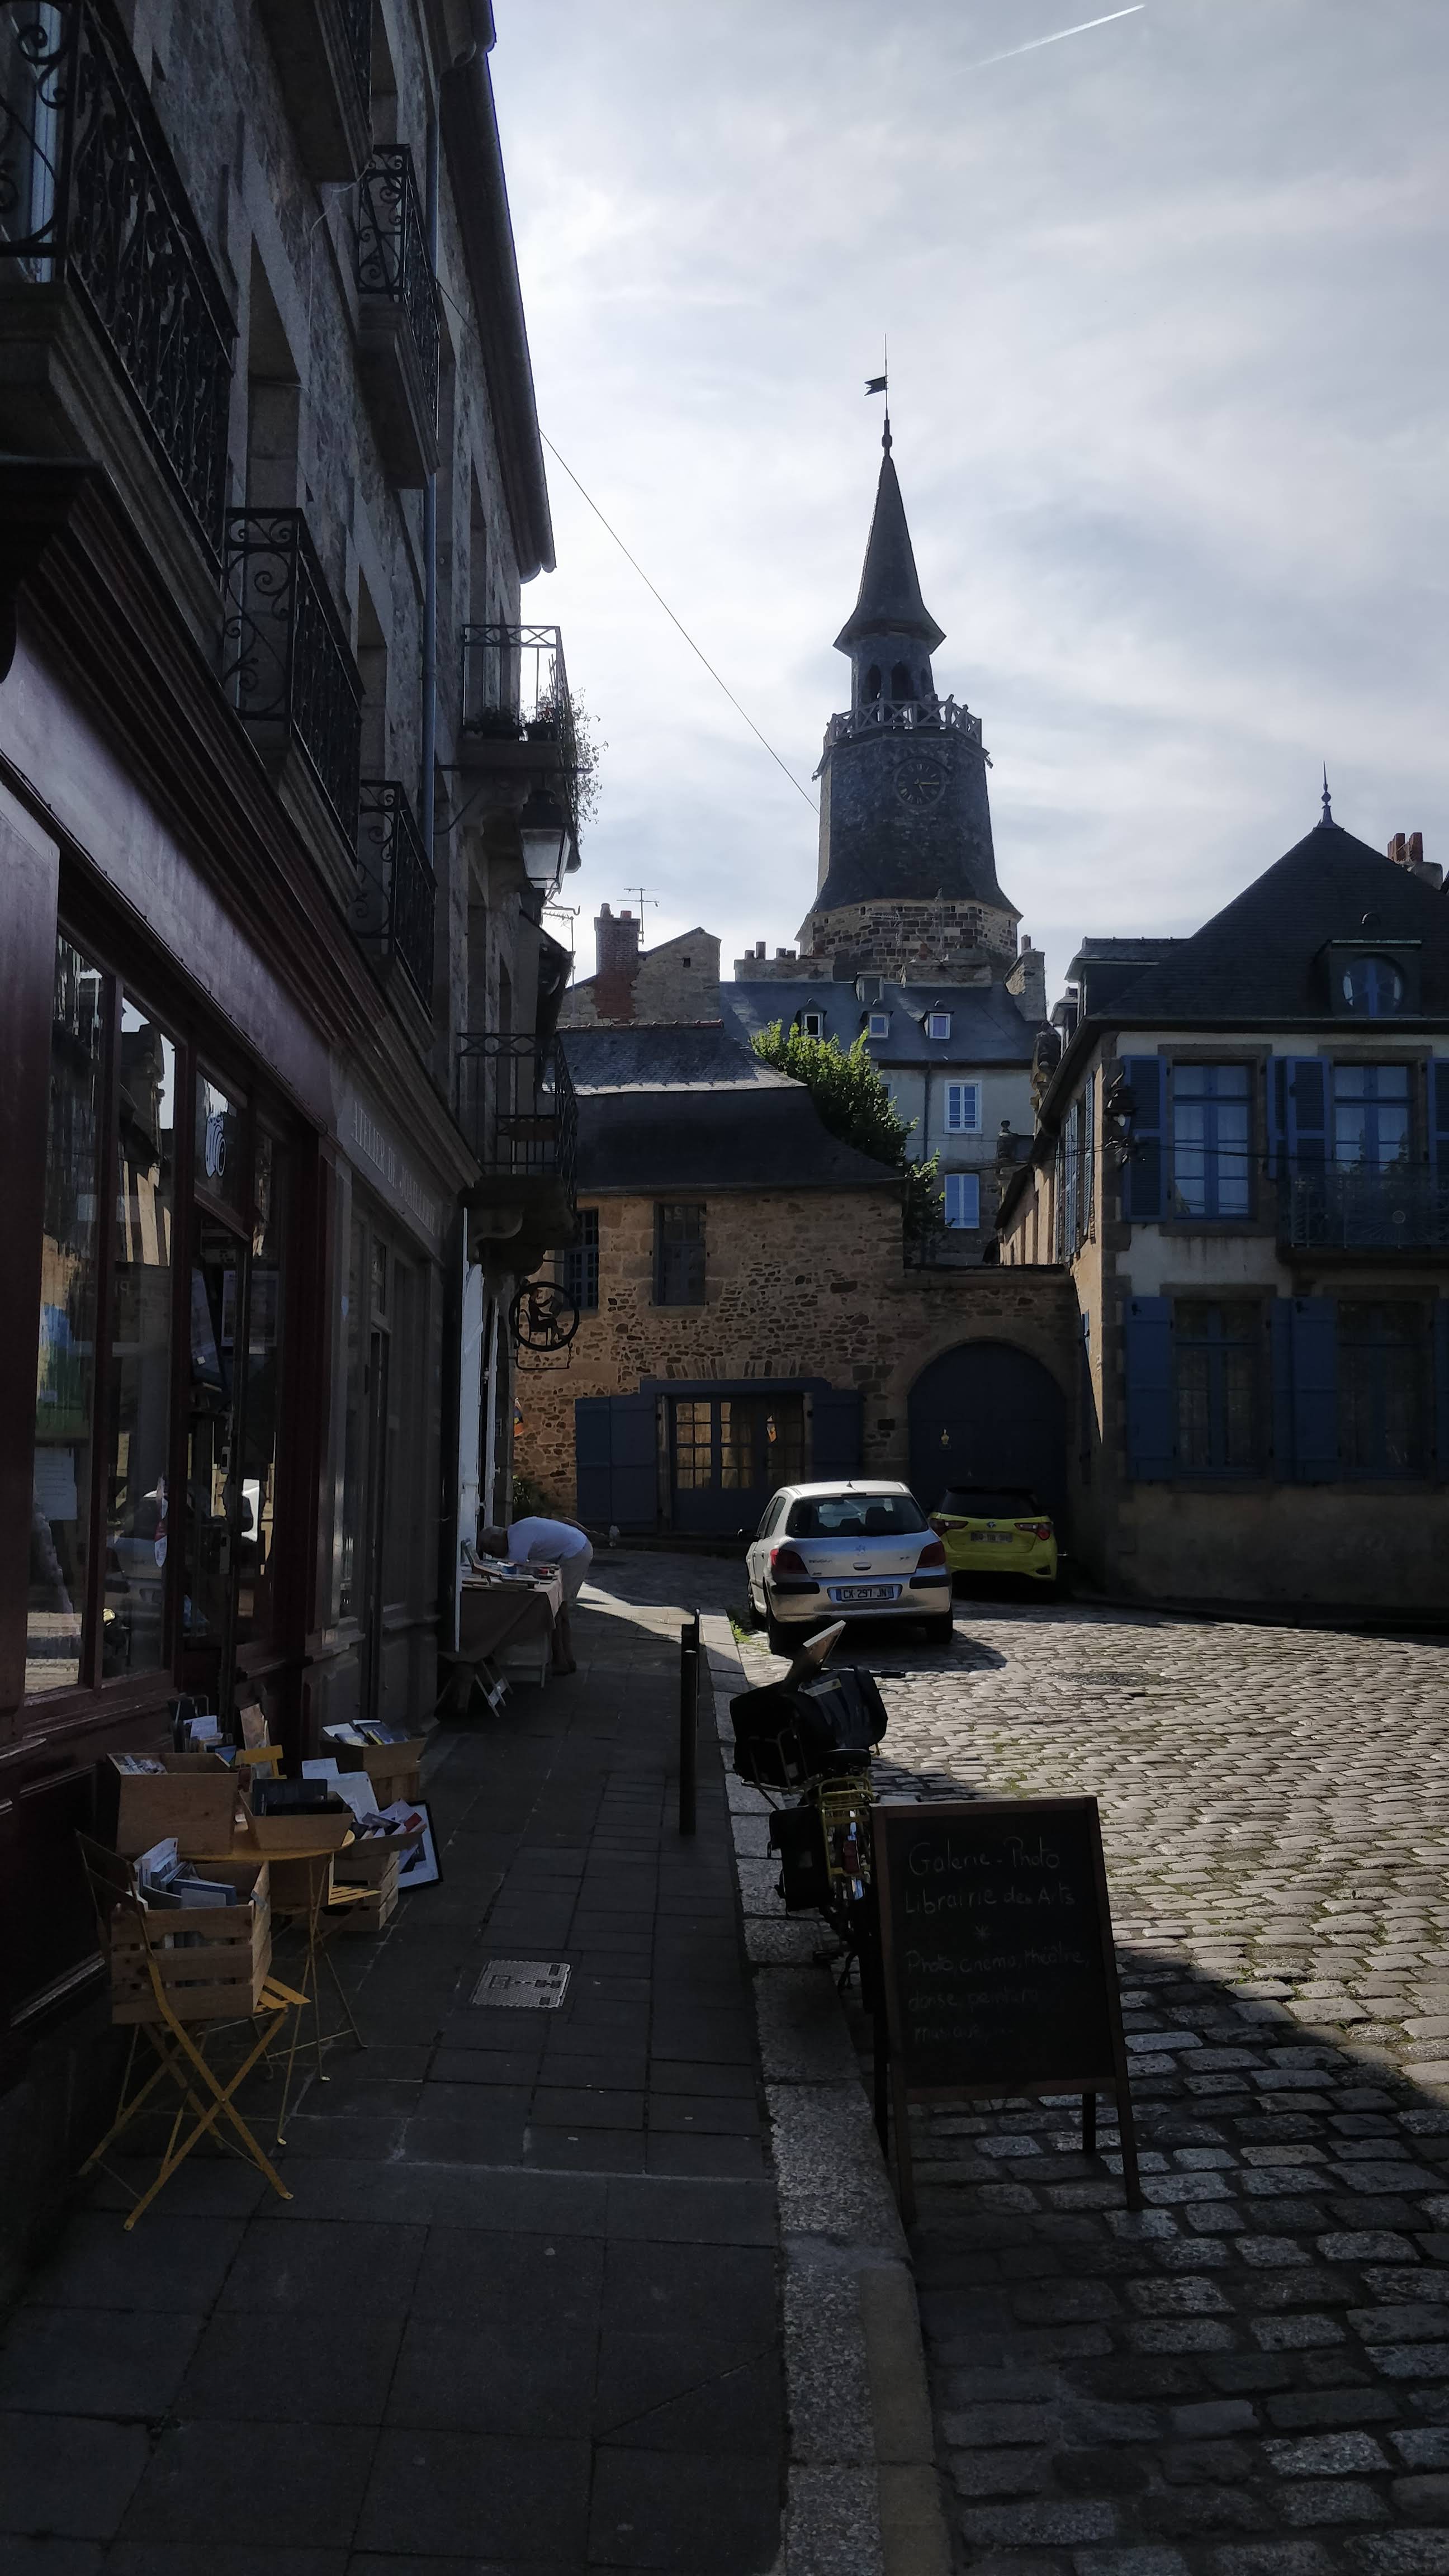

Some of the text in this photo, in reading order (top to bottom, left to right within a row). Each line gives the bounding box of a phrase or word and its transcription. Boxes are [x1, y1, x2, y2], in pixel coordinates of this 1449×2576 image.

[908, 1838, 990, 1877] Galerie
[1002, 1835, 1060, 1869] Photo
[903, 1886, 997, 1915] Librairie
[1037, 1881, 1079, 1906] Arts
